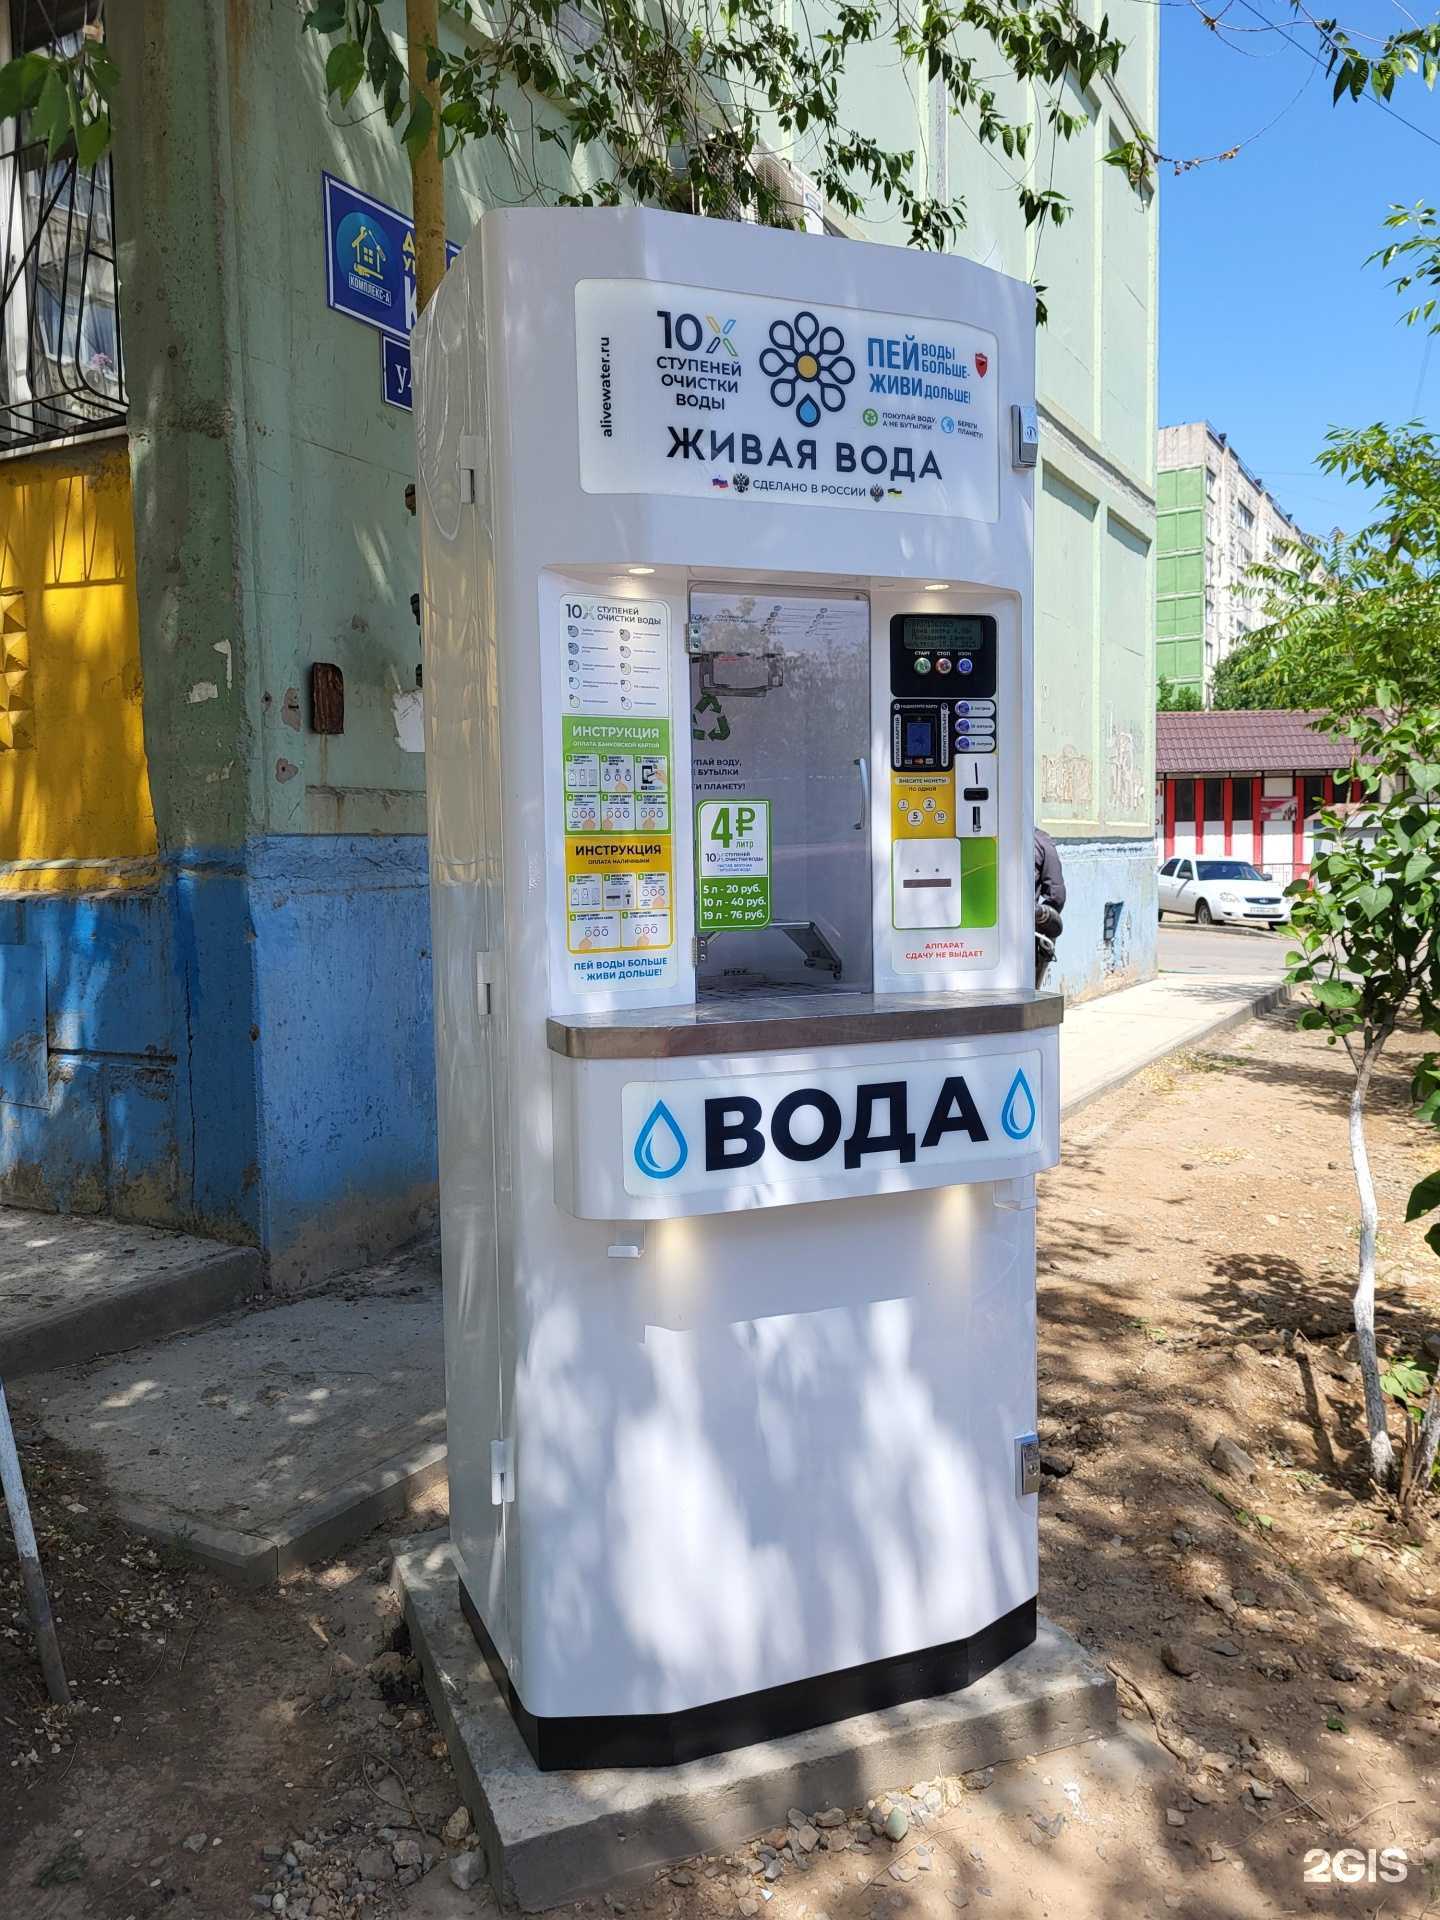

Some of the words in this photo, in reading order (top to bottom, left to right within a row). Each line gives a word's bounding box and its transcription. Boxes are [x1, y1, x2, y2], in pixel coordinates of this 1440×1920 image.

[350, 274, 391, 303] КОМПЛЕКС-А
[867, 334, 920, 371] ПЕЙ
[921, 343, 956, 360] ВОДЫ
[656, 355, 742, 377] СТУПЕНЕЙ
[600, 336, 613, 438] alivewater.ru
[661, 374, 738, 394] ОЧИСТКИ
[869, 373, 923, 398] ЖИВИ
[924, 384, 971, 404] ДОЛЬШЕ!
[676, 393, 725, 411] ВОДЫ
[882, 412, 916, 421] ПОКУПАЙ
[900, 422, 932, 430] БУТЫЛКИ
[666, 426, 818, 470] ЖИВАЯ
[836, 442, 942, 483] ВОДА
[752, 479, 808, 494] СДЕЛАНО
[811, 484, 818, 494] В
[821, 484, 866, 496] РОССИИ
[596, 606, 639, 616] СТУПЕНЕЙ
[596, 614, 636, 622] ОЧИСТКИ
[638, 616, 662, 625] ВОДЫ
[572, 726, 660, 740] ИНСТРУКЦИЯ
[912, 812, 918, 820] 5
[575, 844, 662, 856] ИНСТРУКЦИЯ
[703, 886, 709, 894] 5
[726, 885, 738, 894] 20
[740, 884, 761, 896] руб.
[703, 898, 714, 906] 10
[730, 898, 744, 906] 40
[746, 896, 766, 908] руб.
[703, 912, 714, 920] 19
[730, 910, 742, 919] 76
[744, 910, 766, 921] руб.
[906, 952, 934, 960] СДАЧУ
[574, 960, 594, 970] ПЕЙ
[596, 960, 626, 970] ВОДЫ
[628, 957, 668, 968] БОЛЬШЕ
[586, 972, 616, 980] ЖИВИ
[618, 968, 662, 980] ДОЛЬШЕ!
[704, 1075, 990, 1172] ВОДА
